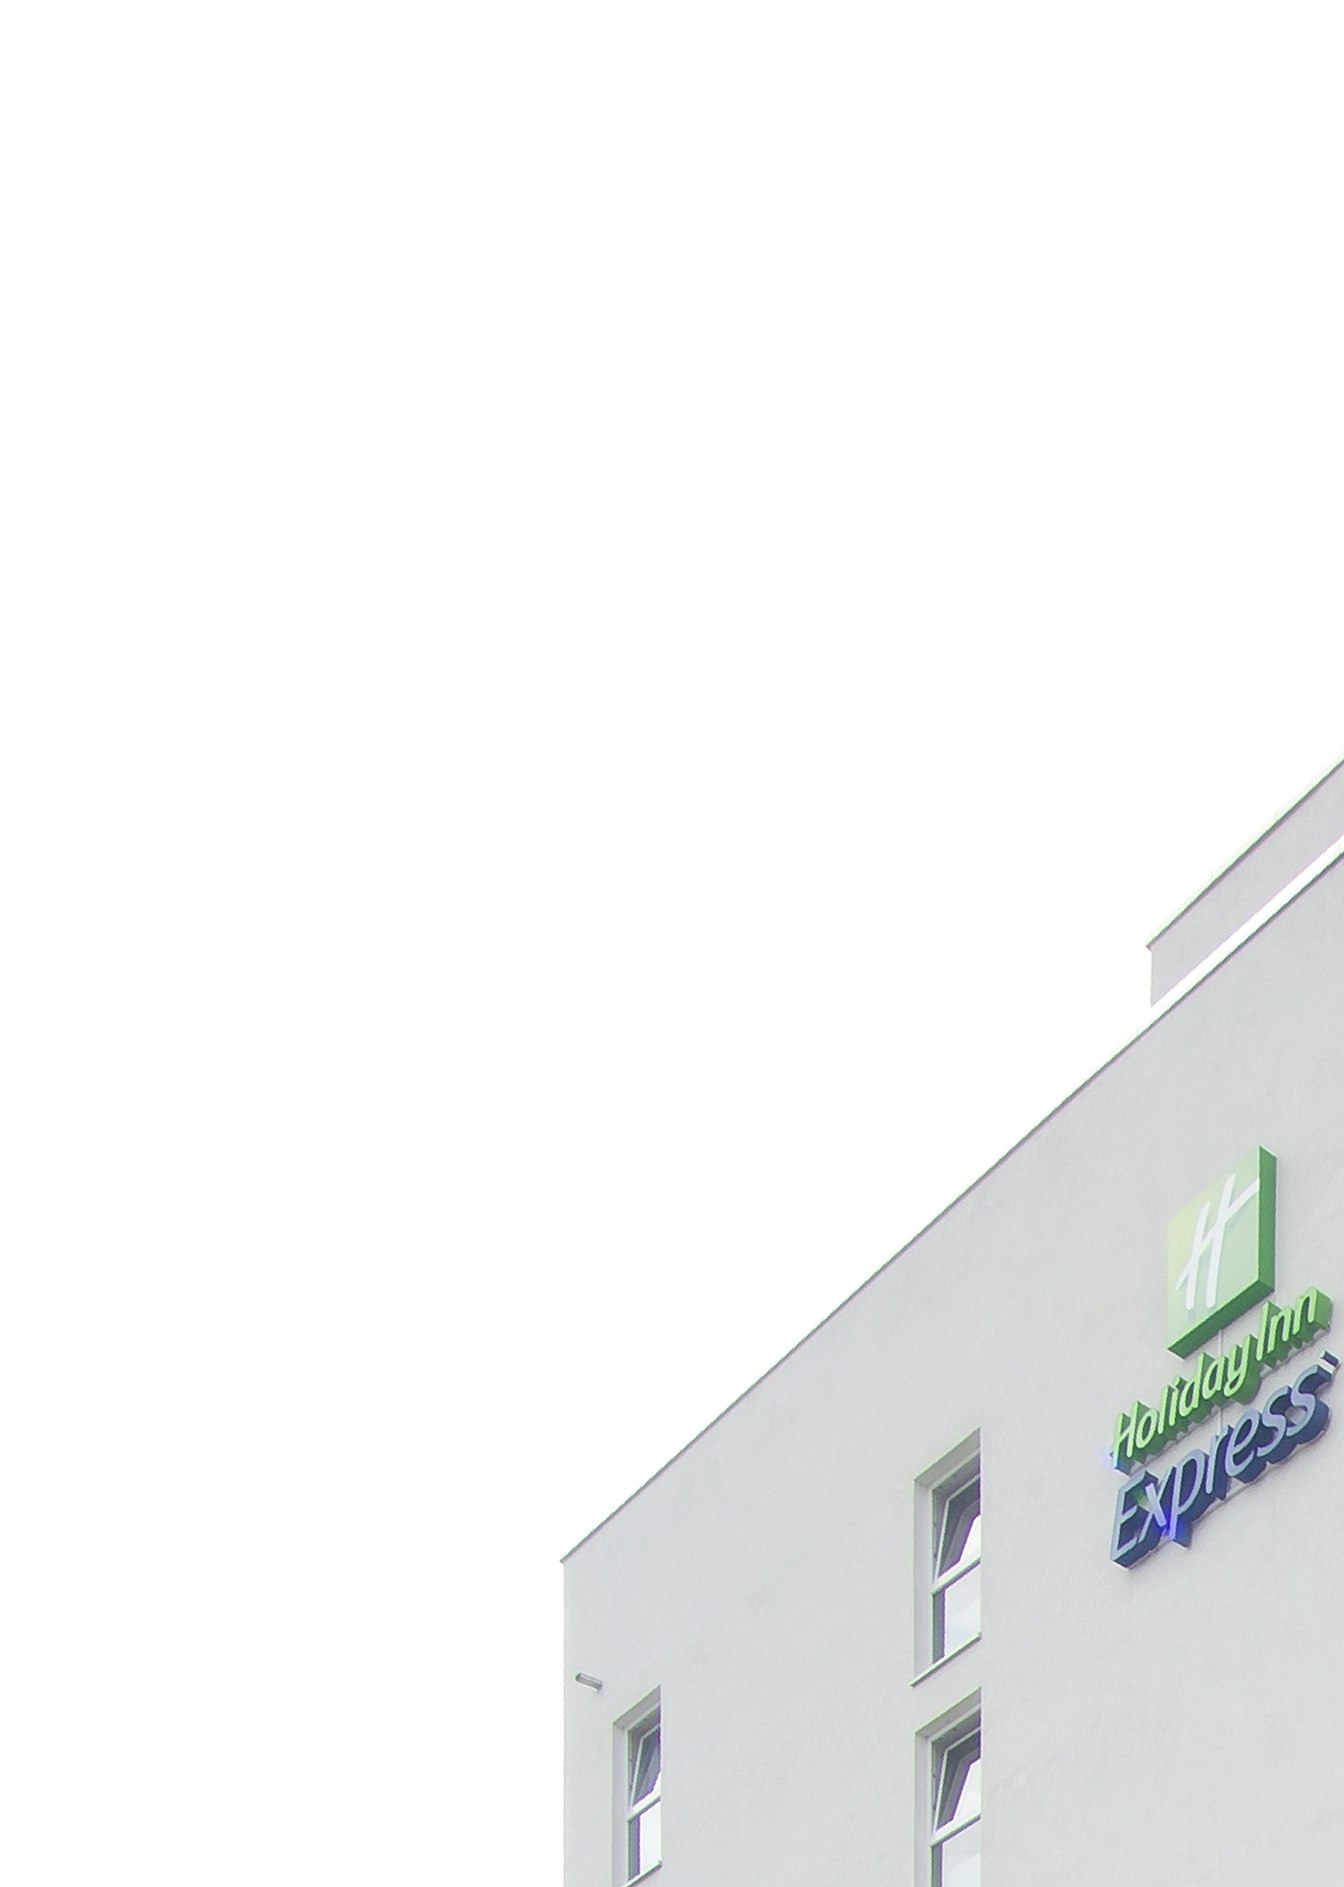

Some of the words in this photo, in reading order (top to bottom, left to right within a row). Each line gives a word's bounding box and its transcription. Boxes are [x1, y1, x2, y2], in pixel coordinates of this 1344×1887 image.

[1110, 1355, 1332, 1568] Express
[1112, 1333, 1258, 1474] Holiday
[1255, 1287, 1332, 1369] Inn
